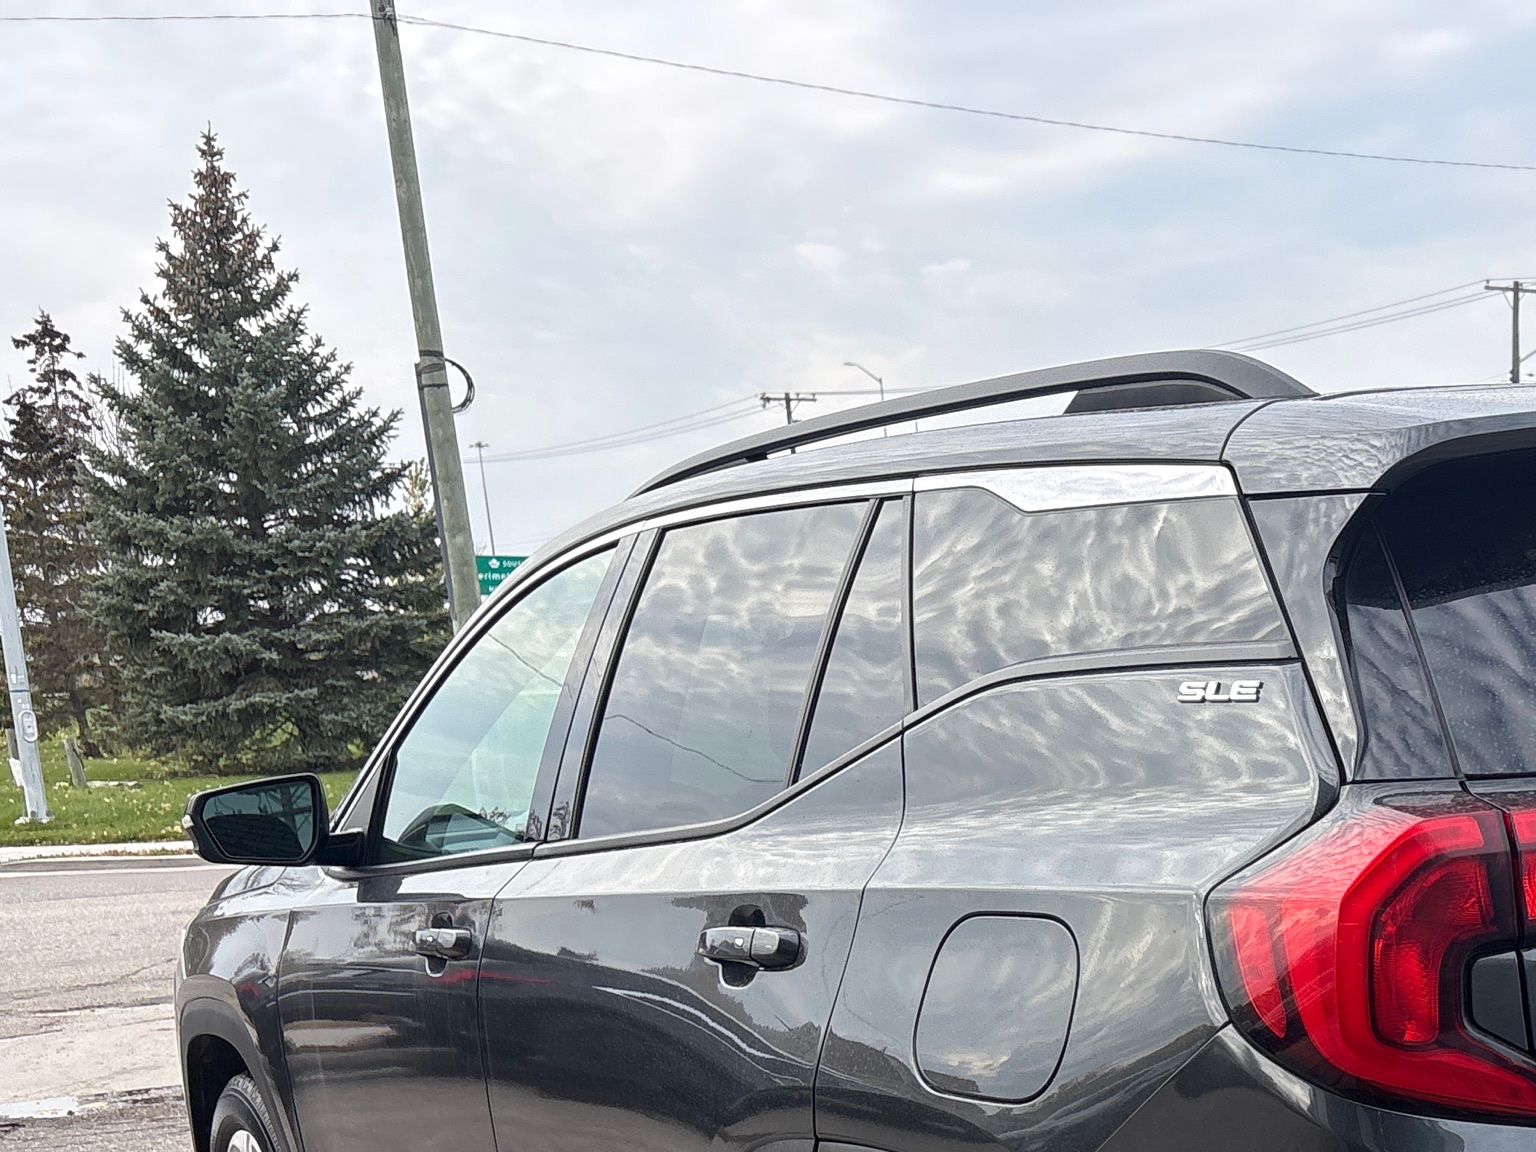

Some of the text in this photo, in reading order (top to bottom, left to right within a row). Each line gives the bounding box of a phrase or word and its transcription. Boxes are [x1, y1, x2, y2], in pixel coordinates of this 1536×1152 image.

[503, 560, 521, 568] SOU
[478, 571, 510, 581] erime
[1177, 680, 1264, 703] SLE
